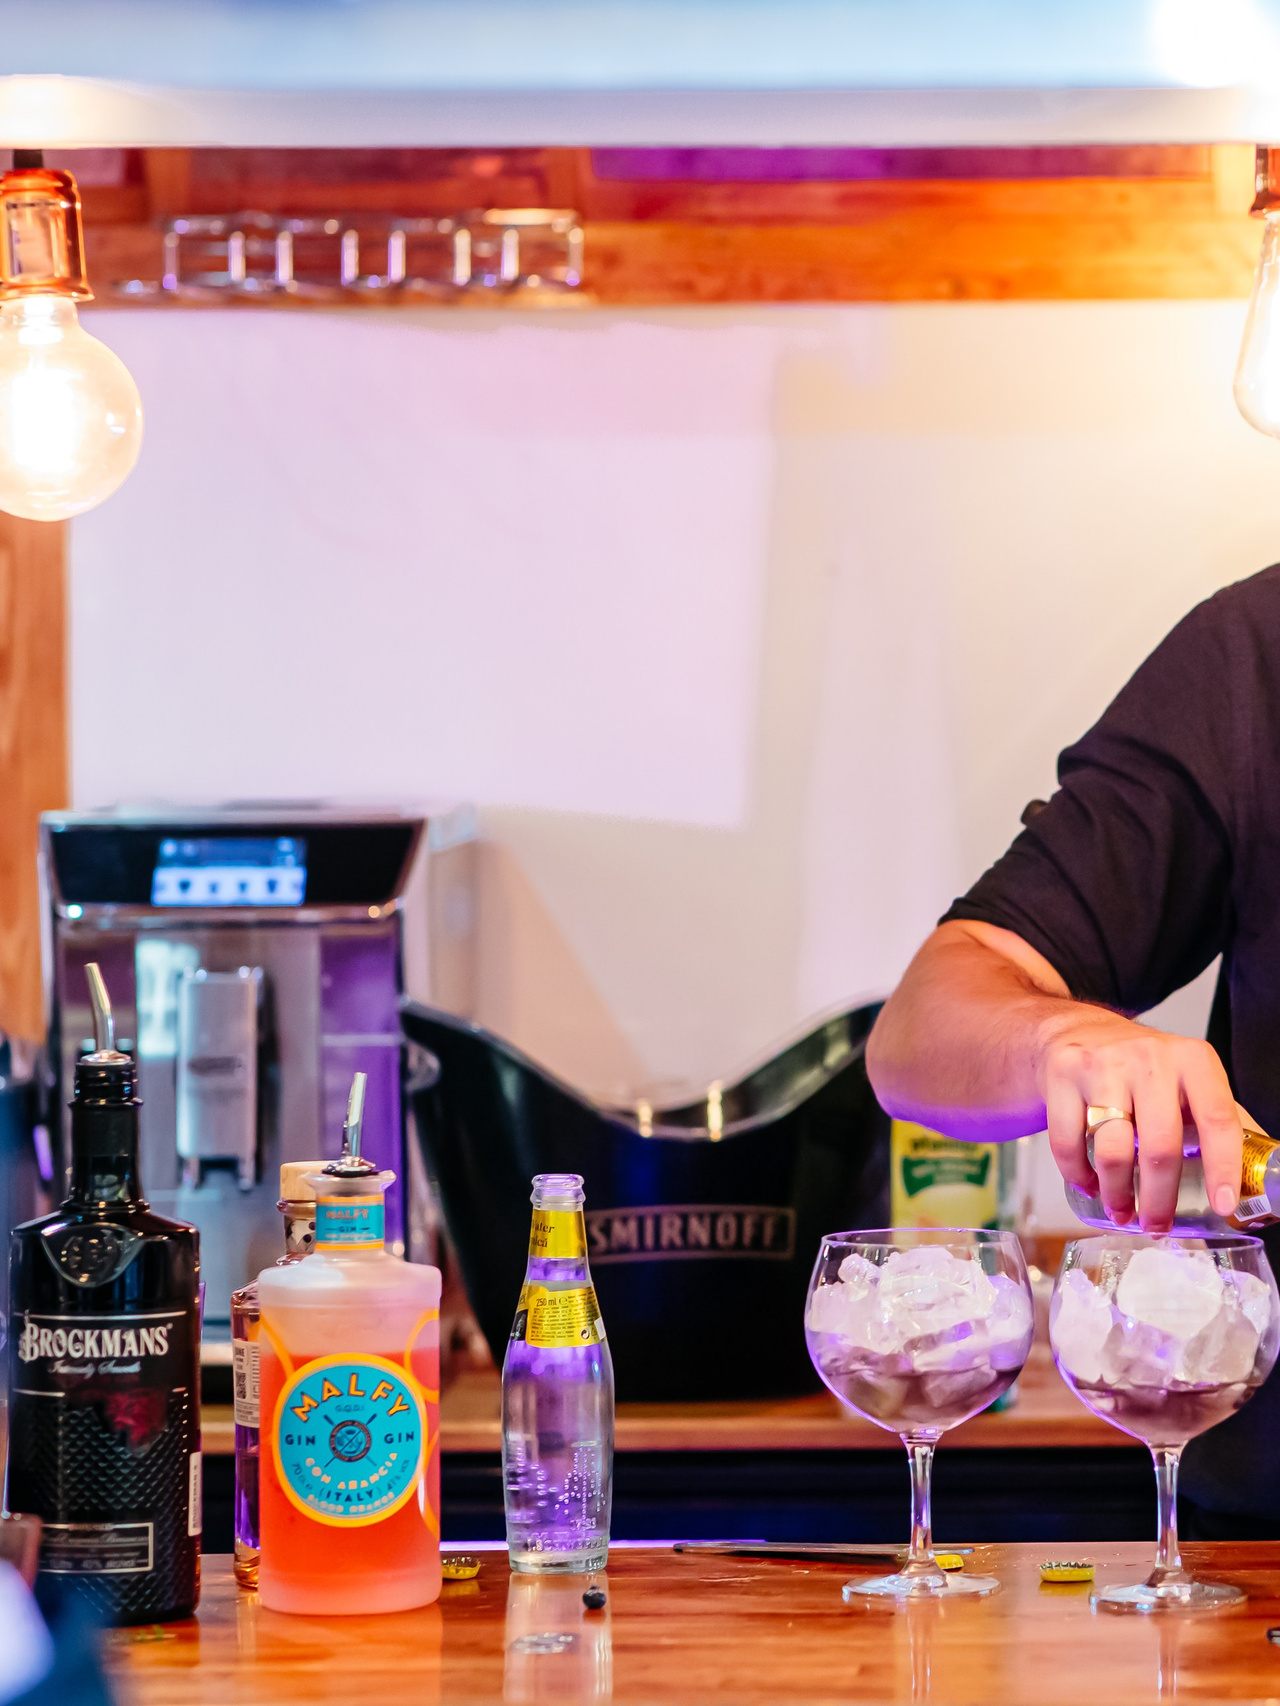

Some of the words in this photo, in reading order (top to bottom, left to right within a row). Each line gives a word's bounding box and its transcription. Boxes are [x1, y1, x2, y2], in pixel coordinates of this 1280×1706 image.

[326, 1208, 370, 1220] MALFY
[588, 1213, 779, 1252] SMIRNOFF
[536, 1297, 547, 1307] 250
[548, 1297, 557, 1306] ml
[18, 1320, 170, 1363] BROCKMANS
[290, 1373, 410, 1423] MALFY
[284, 1433, 317, 1447] GIN
[383, 1430, 415, 1445] GIN
